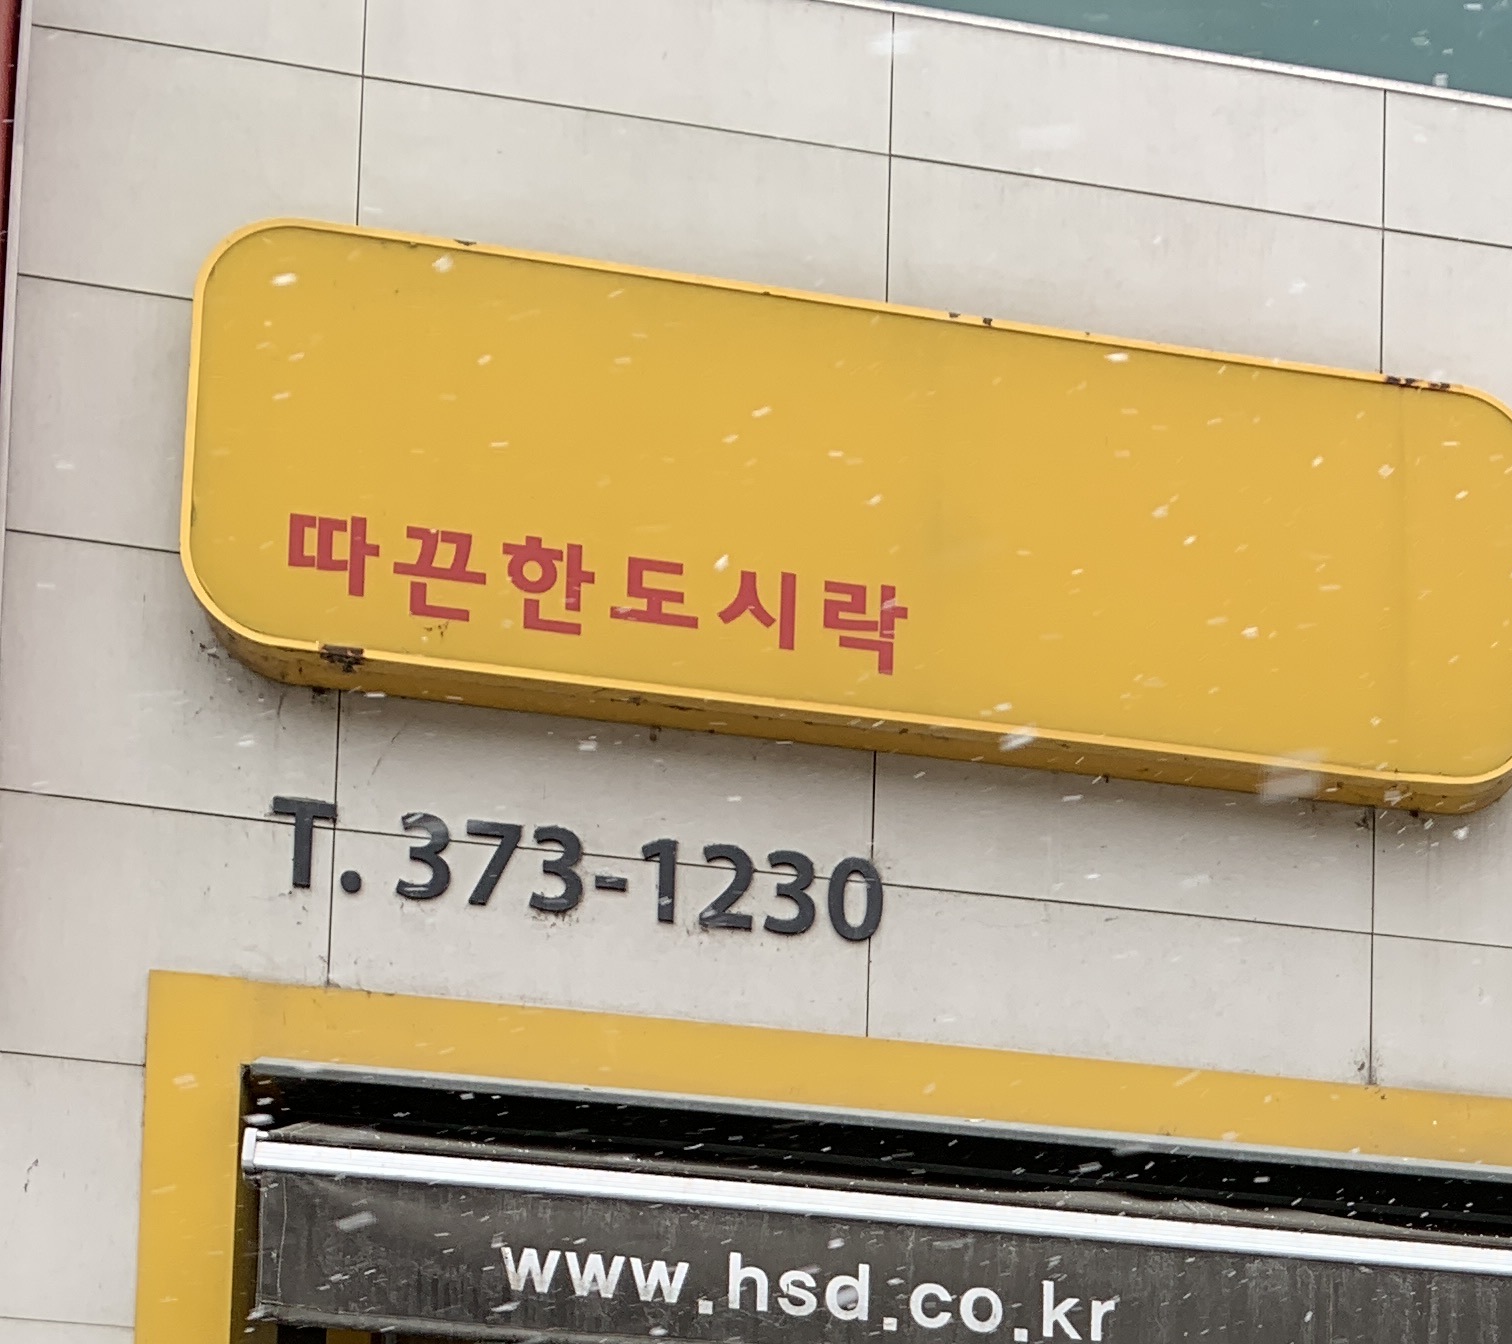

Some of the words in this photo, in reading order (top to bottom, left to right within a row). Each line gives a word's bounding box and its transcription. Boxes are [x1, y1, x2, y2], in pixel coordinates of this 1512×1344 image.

[287, 512, 910, 677] 따끈한도시락
[396, 811, 885, 944] 373-1230
[500, 1244, 1116, 1343] www.hsd.co.kr
